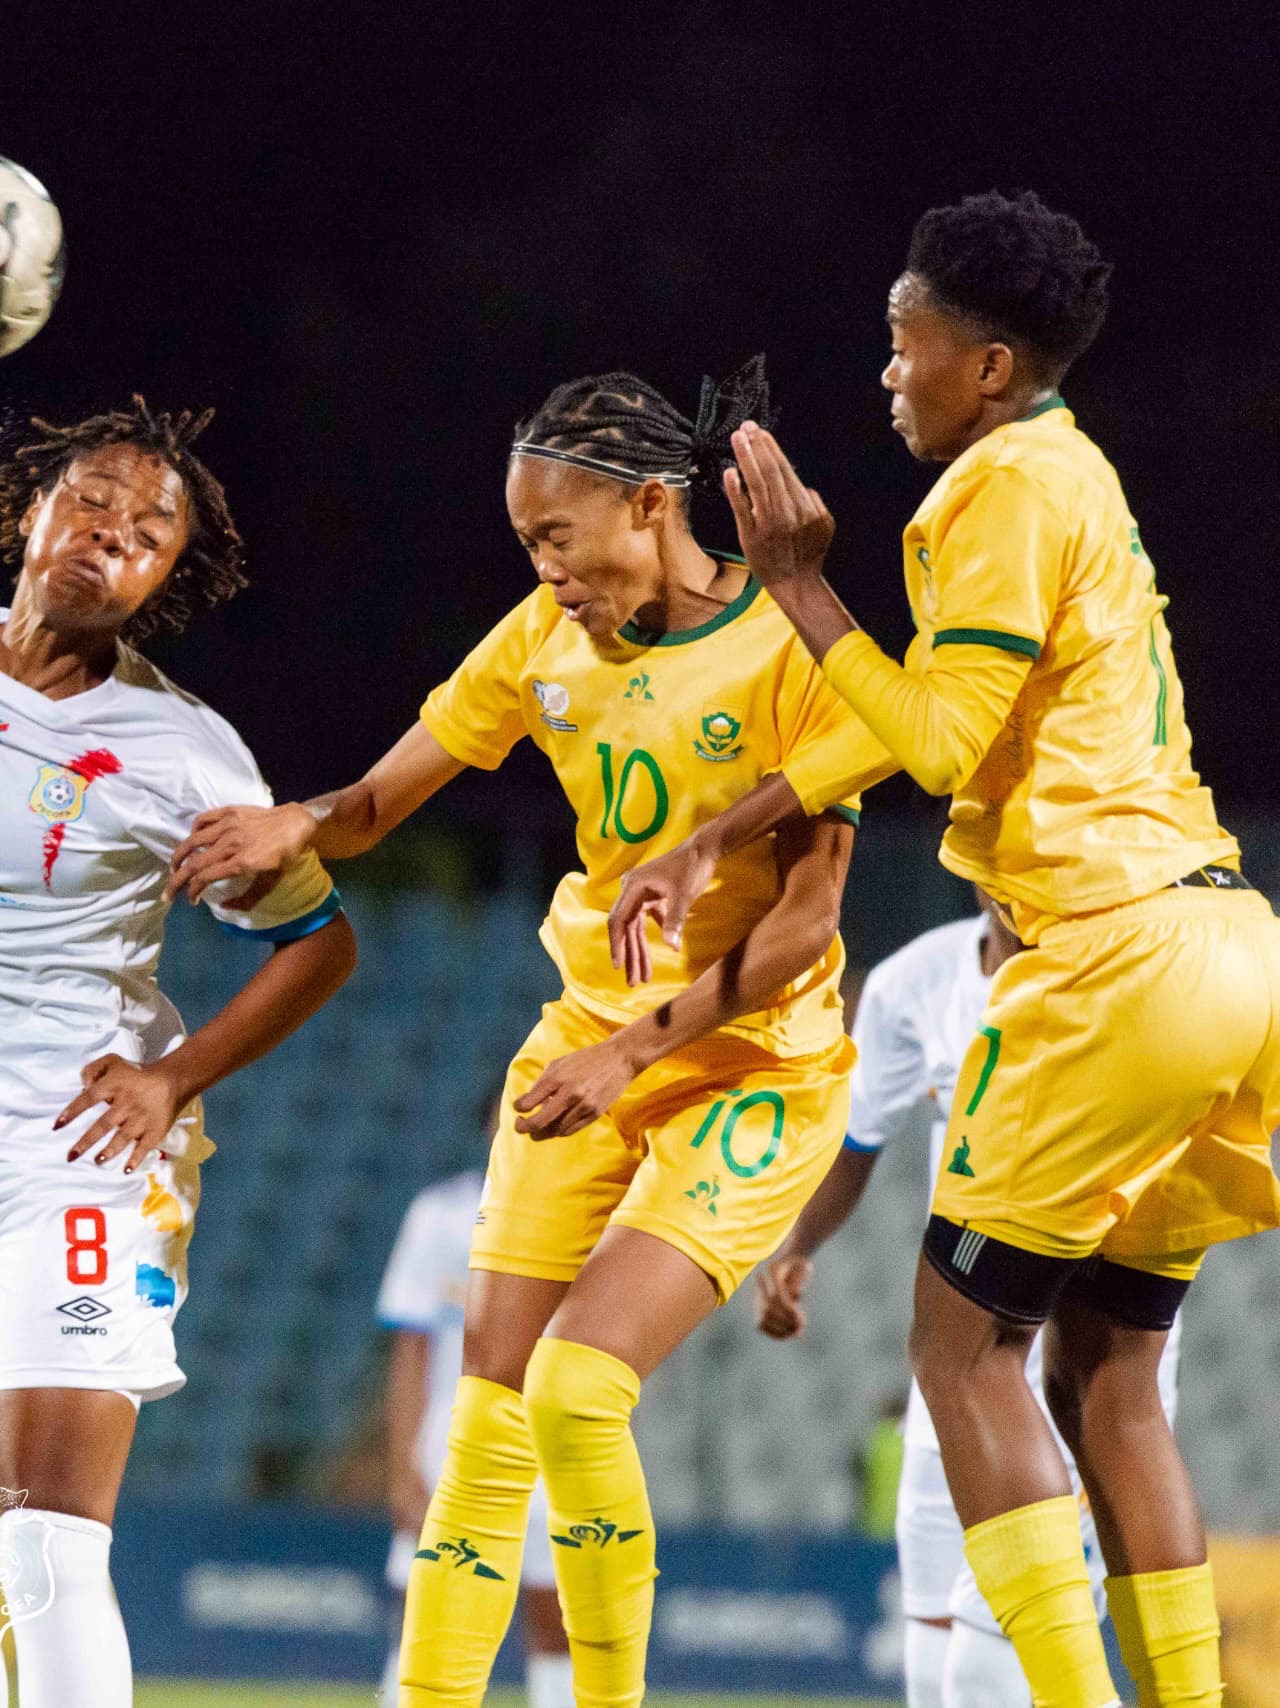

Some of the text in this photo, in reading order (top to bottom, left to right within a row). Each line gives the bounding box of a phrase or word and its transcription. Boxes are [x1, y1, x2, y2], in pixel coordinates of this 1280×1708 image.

[597, 742, 668, 844] 10
[690, 1089, 784, 1178] 10
[64, 1206, 108, 1285] 8
[61, 1322, 107, 1336] umbro
